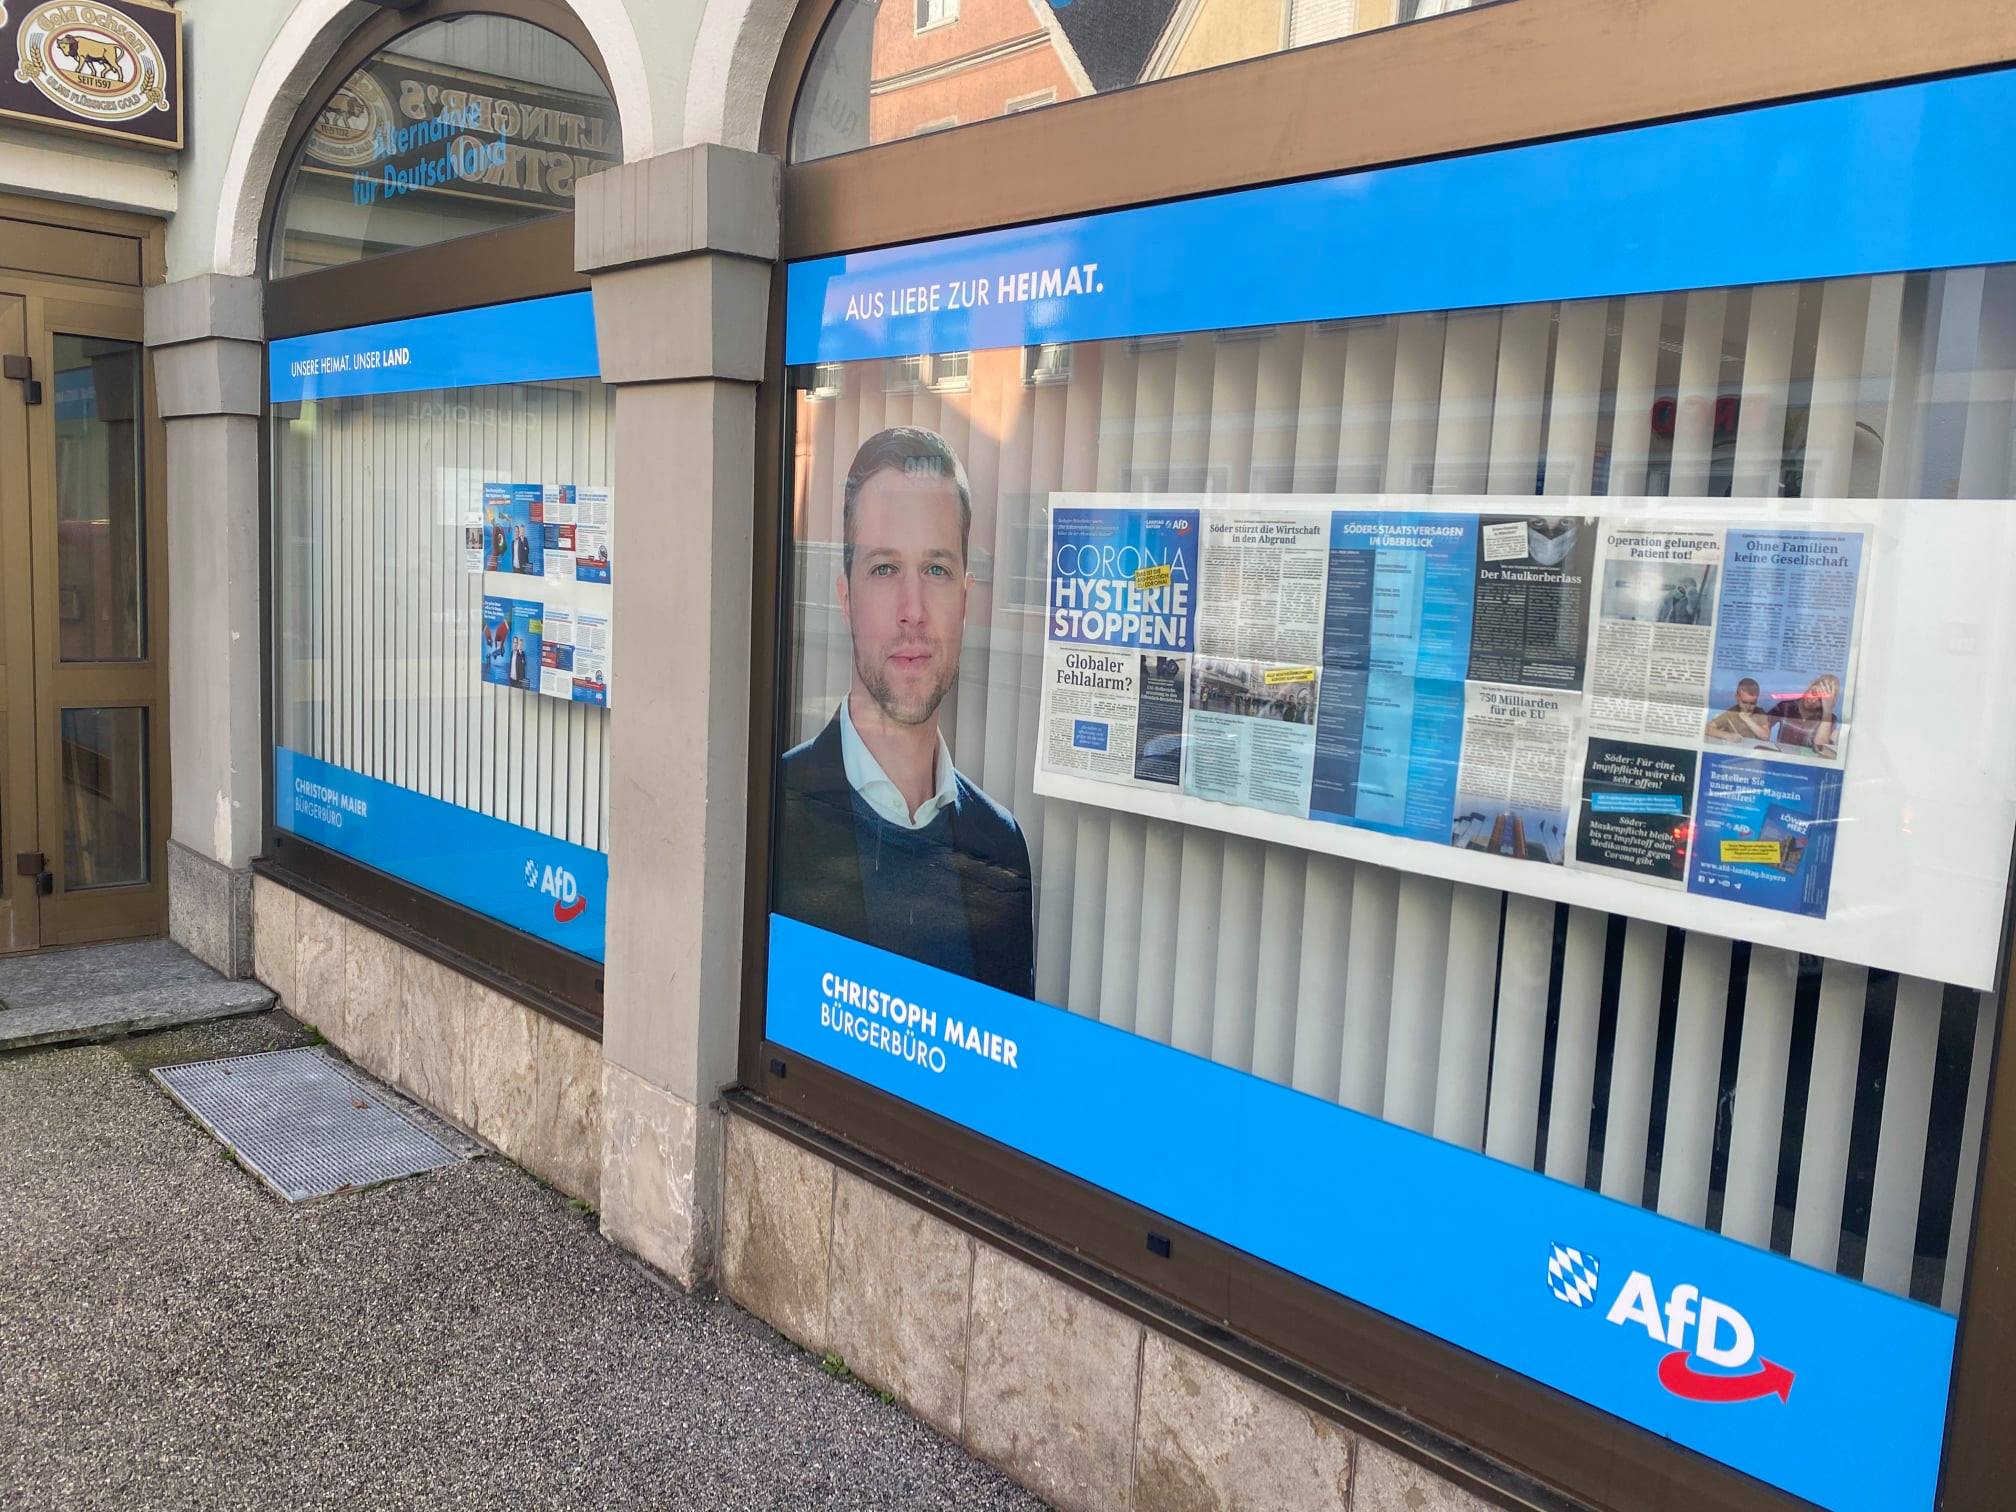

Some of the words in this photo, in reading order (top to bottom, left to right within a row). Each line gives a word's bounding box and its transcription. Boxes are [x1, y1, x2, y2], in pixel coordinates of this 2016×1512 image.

[37, 6, 79, 31] Gold
[81, 7, 147, 54] Ochsen
[78, 74, 94, 86] SEIT
[95, 79, 112, 89] 1597
[118, 94, 141, 110] GOLD
[373, 100, 482, 159] Alternative
[352, 170, 377, 207] für
[384, 128, 507, 199] Deutschland
[845, 291, 884, 321] AUS
[891, 284, 940, 316] LIEBE
[947, 278, 989, 310] ZUR
[997, 263, 1104, 304] HEIMAT.
[291, 359, 319, 377] UNSERE
[321, 355, 351, 373] HEIMAT.
[353, 351, 381, 370] UNSER
[383, 347, 412, 367] LAND.
[1172, 520, 1188, 529] AfD
[1209, 523, 1233, 533] Söder
[1235, 524, 1259, 534] stürzt
[1260, 525, 1274, 534] die
[1276, 525, 1321, 535] Wirtschaft
[1344, 522, 1379, 534] SÖDERS
[1379, 524, 1463, 537] STAATSVERSAGEN
[1232, 535, 1241, 543] in
[1242, 535, 1257, 543] den
[1258, 535, 1296, 546] Abgrund
[1370, 537, 1380, 546] IM
[1382, 535, 1433, 548] ÜBERBLICK
[1607, 536, 1662, 548] Operation
[1747, 540, 1779, 552] Ohne
[1782, 542, 1838, 554] Familien
[1057, 544, 1188, 580] CORONA
[1630, 548, 1669, 559] Patient
[1672, 551, 1692, 560] tot!
[1734, 552, 1768, 564] keine
[1771, 555, 1849, 567] Gesellschaft
[1480, 570, 1499, 579] Der
[1501, 570, 1582, 584] Maulkorberlass
[1055, 577, 1189, 615] HYSTERIE
[1054, 608, 1187, 648] STOPPEN!
[1066, 654, 1124, 673] Globaler
[1056, 669, 1133, 691] Fehlalarm?
[1480, 693, 1496, 703] 750
[1499, 694, 1558, 709] Milliarden
[1490, 704, 1506, 715] für
[1509, 706, 1527, 717] die
[1530, 709, 1546, 719] EU
[1604, 753, 1634, 764] Söder:
[1636, 757, 1654, 768] Für
[1655, 761, 1675, 771] eine
[1592, 761, 1643, 777] Impfpflicht
[1645, 769, 1669, 780] wäre
[1671, 771, 1685, 782] ich
[1710, 770, 1749, 784] Bestellen
[1752, 776, 1765, 786] Sie
[1613, 776, 1634, 785] sehr
[1635, 778, 1663, 790] offen!
[1709, 781, 1734, 791] unser
[1763, 789, 1801, 801] Magazin
[295, 778, 339, 804] CHRISTOPH
[340, 795, 368, 818] MAIER
[295, 796, 343, 828] BÜRGERBÜRO
[1590, 820, 1647, 838] Maskenpflicht
[1619, 816, 1646, 828] Söder:
[1589, 830, 1601, 839] bis
[1590, 839, 1646, 855] Medikamente
[1604, 850, 1634, 862] Corona
[540, 865, 577, 903] AfD
[821, 972, 937, 1037] CHRISTOPH
[944, 1016, 1019, 1070] MAIER
[821, 1000, 946, 1073] BÜRGERBÜRO
[1605, 1270, 1755, 1368] AfD
